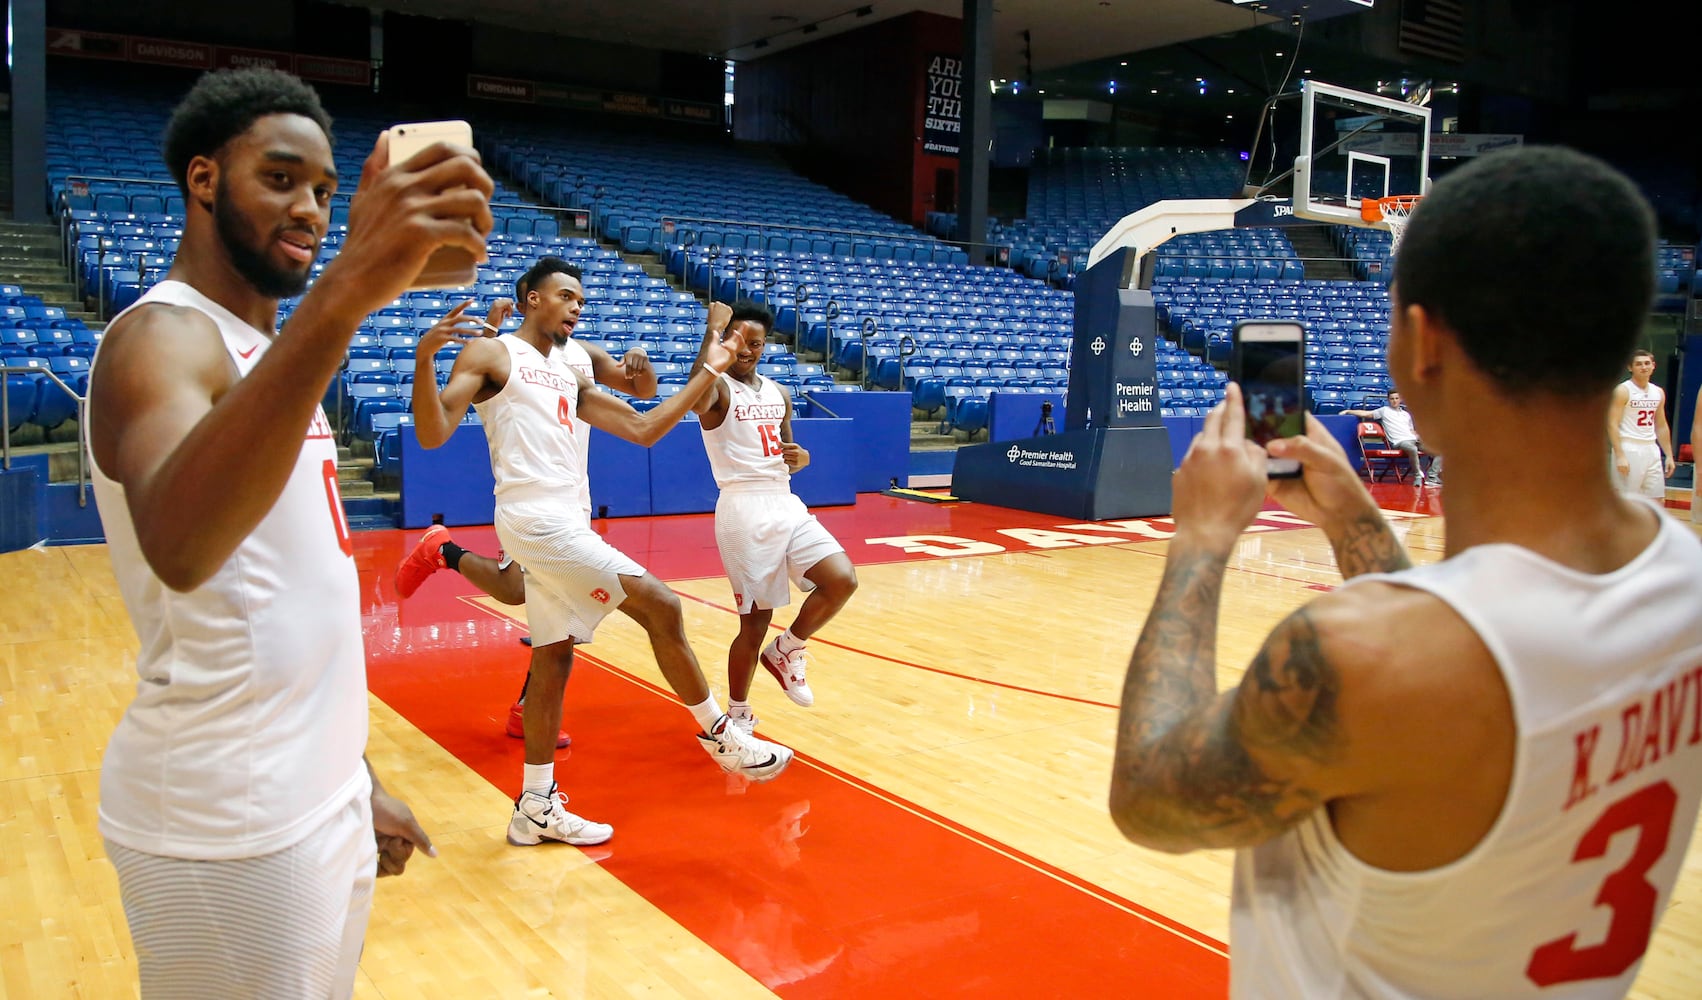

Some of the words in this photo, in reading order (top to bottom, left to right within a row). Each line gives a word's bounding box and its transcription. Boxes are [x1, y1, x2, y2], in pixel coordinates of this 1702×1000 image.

[137, 43, 205, 61] DAVIDSON
[230, 55, 277, 68] DAYTON
[476, 81, 527, 96] FORDHAM
[1116, 382, 1153, 395] Premier
[1119, 398, 1152, 412] Health
[557, 395, 573, 434] 4
[1637, 410, 1655, 427] 23
[757, 424, 783, 457] 15
[1020, 449, 1048, 460] Premier
[1049, 451, 1074, 462] Health
[1032, 460, 1056, 468] Samaritan
[1056, 462, 1077, 470] Hospital
[1525, 779, 1678, 988] 3
